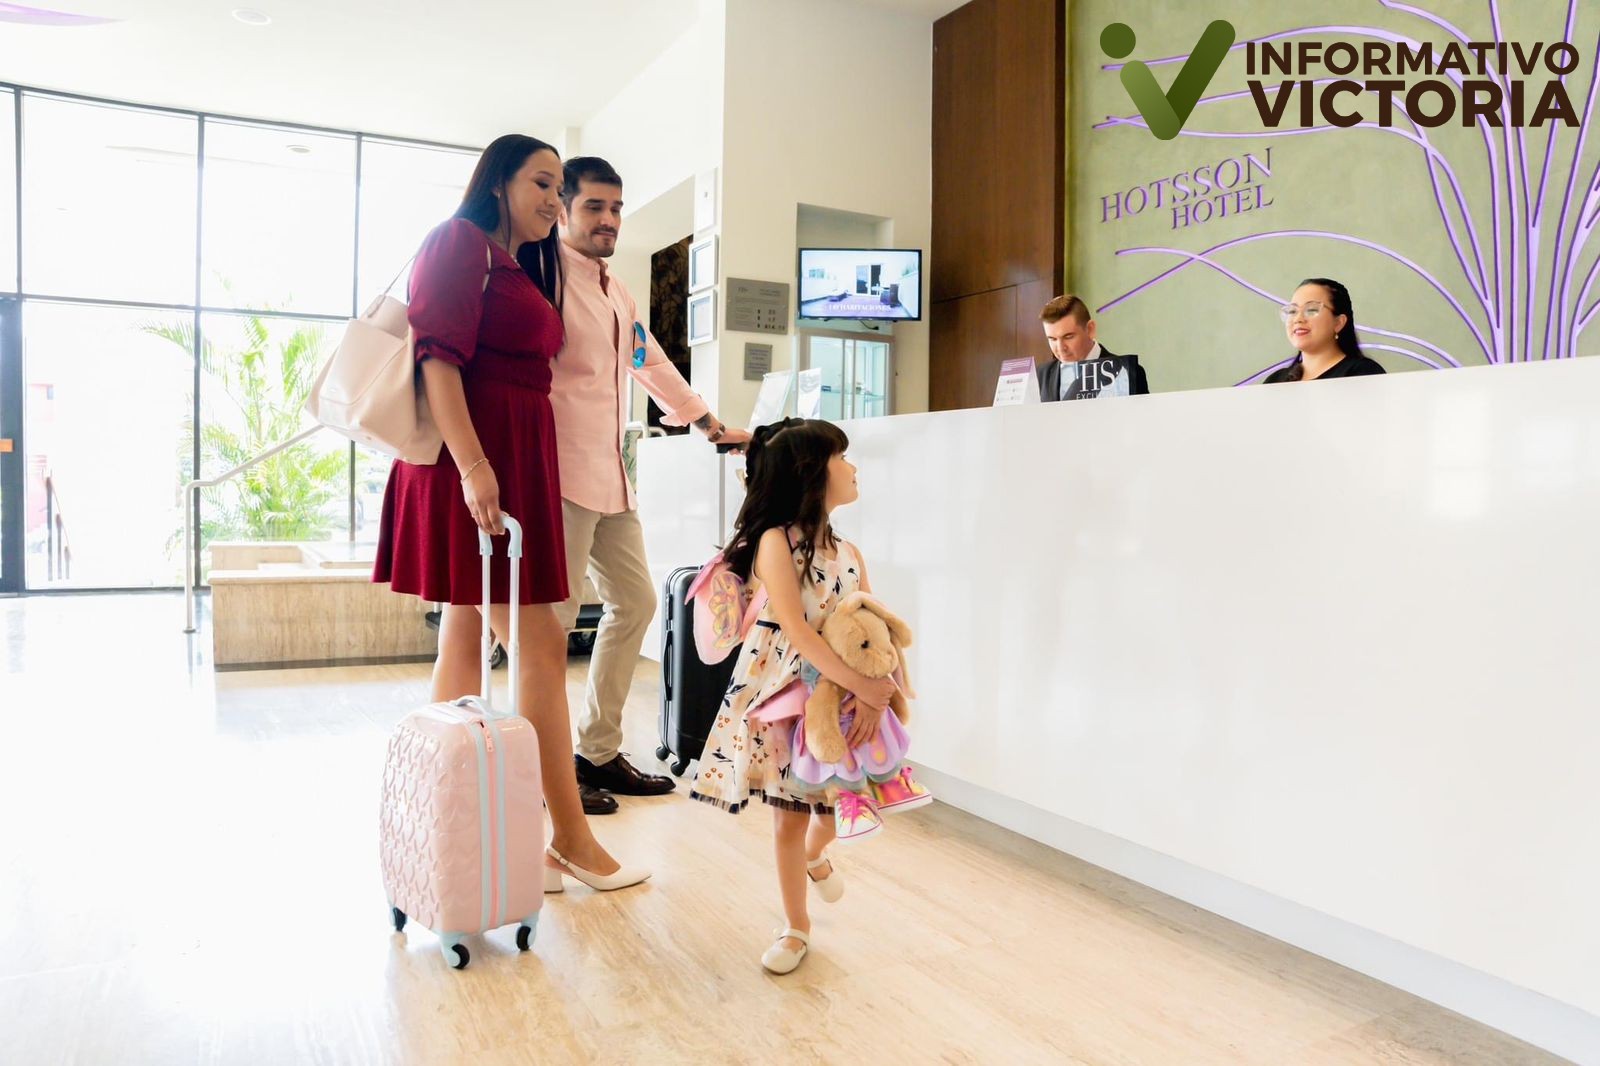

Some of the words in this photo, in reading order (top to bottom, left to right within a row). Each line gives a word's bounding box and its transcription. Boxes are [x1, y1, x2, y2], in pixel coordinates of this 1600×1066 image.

[1100, 147, 1273, 224] HOTSSON
[1171, 185, 1275, 230] HOTEL
[1079, 360, 1115, 392] HS
